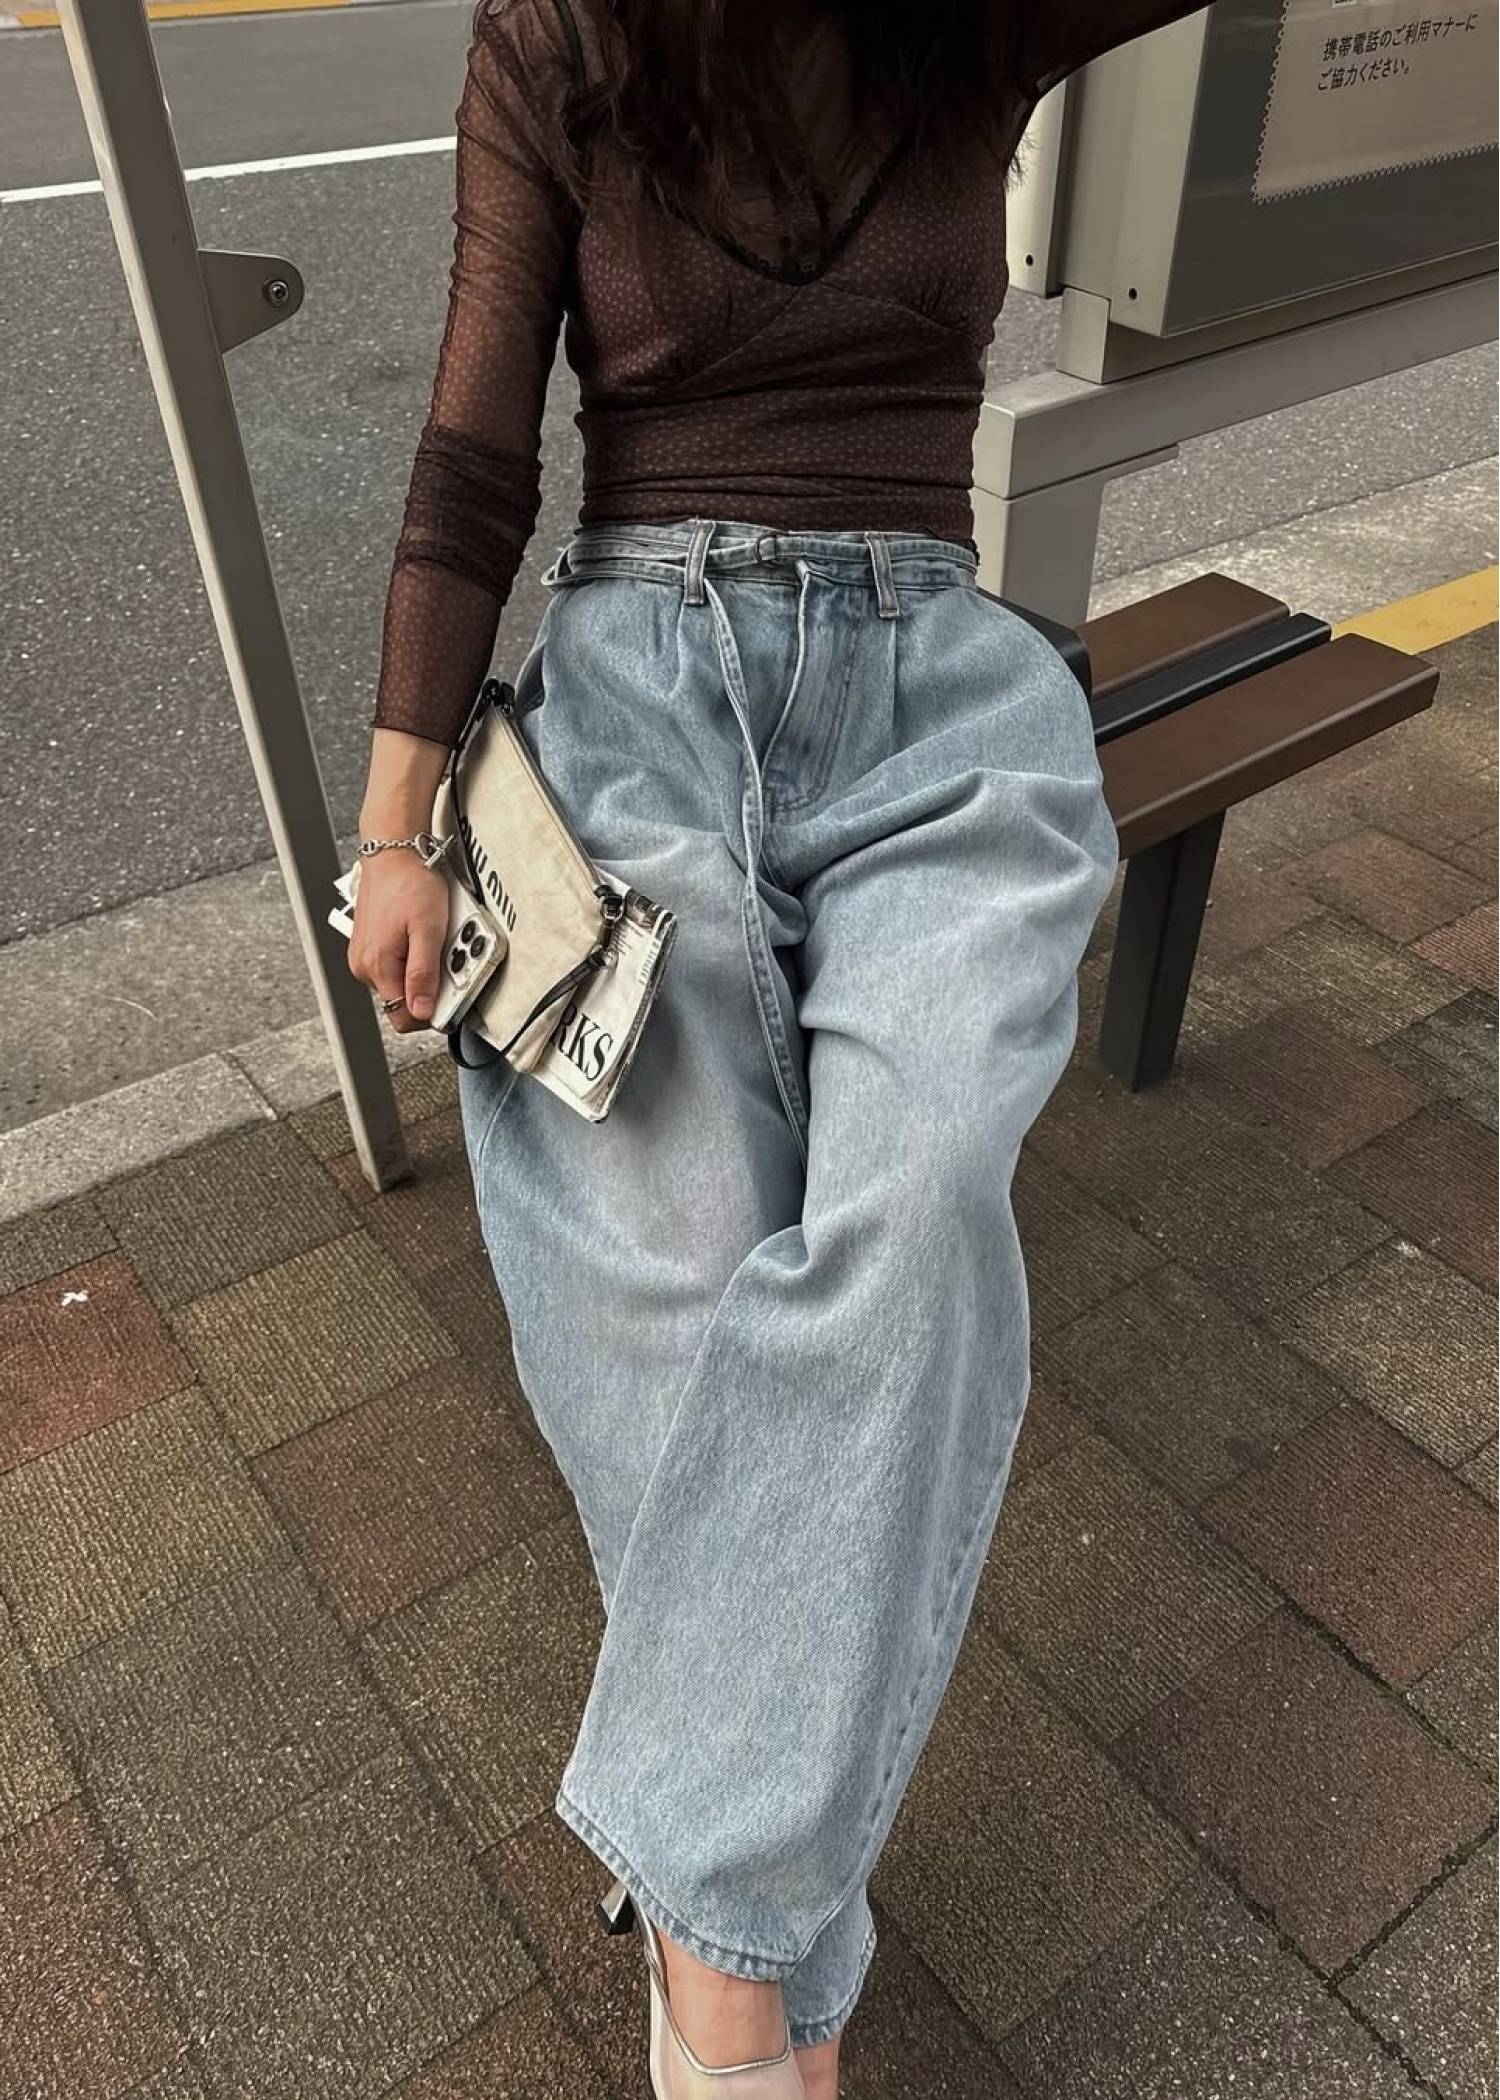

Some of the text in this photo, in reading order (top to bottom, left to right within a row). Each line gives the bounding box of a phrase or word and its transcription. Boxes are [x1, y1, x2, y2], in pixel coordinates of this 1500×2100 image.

[1323, 13, 1478, 61] 携帯電話のご利用マナーに
[1318, 57, 1410, 91] ご協力ください。
[486, 870, 517, 932] miu
